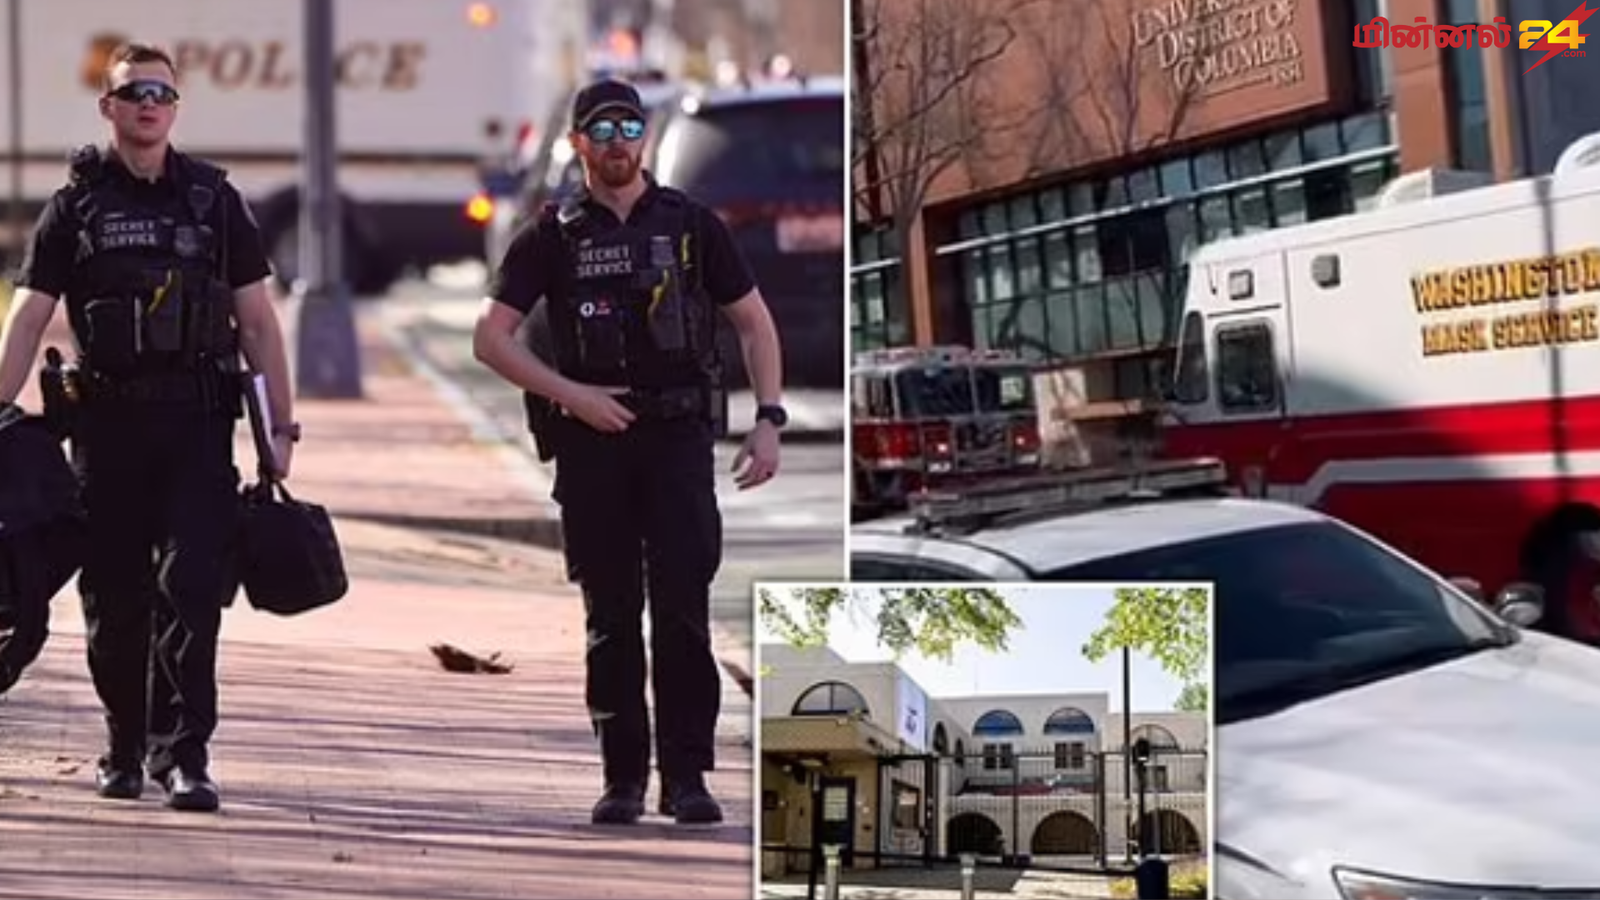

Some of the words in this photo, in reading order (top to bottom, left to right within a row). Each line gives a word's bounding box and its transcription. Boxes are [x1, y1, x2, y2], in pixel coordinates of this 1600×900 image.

[172, 39, 427, 91] POLCE
[103, 219, 155, 234] SECRET
[101, 233, 158, 249] SERVICE
[579, 245, 630, 263] SECRET
[576, 260, 632, 278] SERVICE
